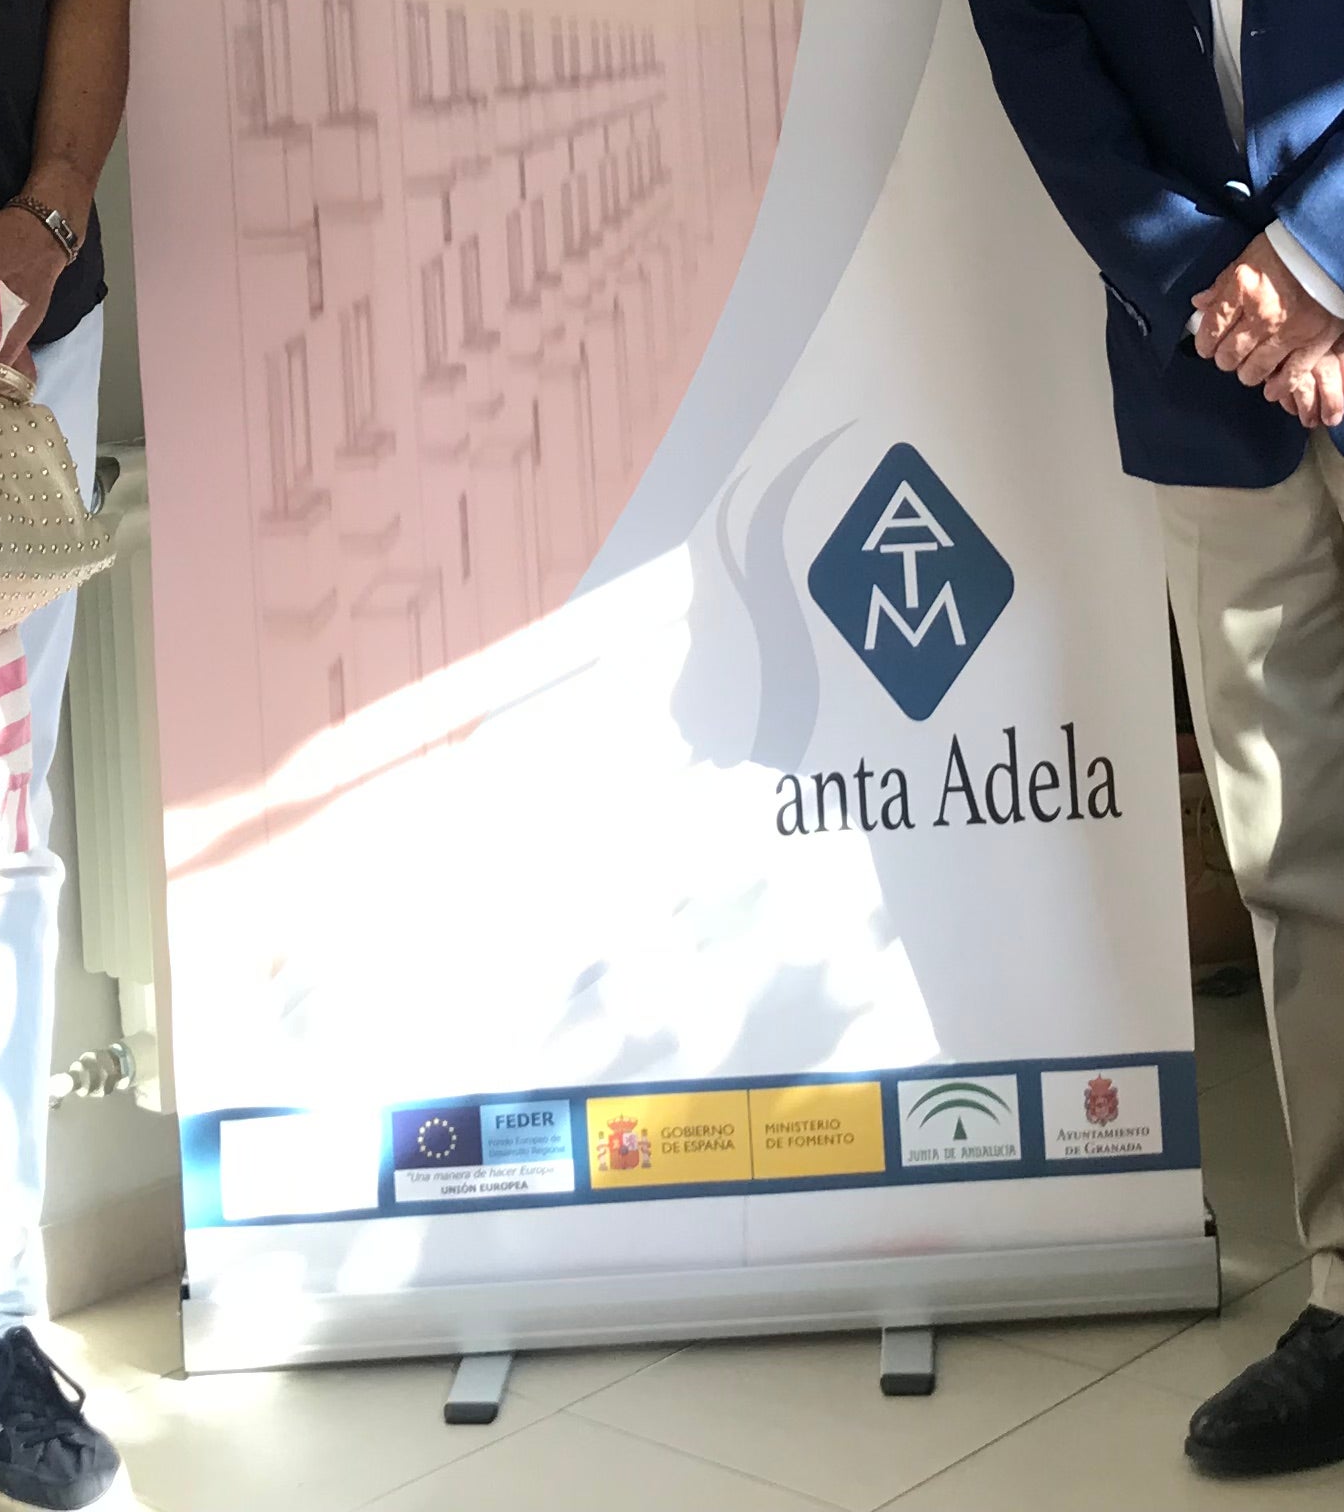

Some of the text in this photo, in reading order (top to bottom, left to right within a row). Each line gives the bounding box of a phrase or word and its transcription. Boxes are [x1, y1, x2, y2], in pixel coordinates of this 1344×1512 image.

[933, 722, 1123, 826] Adela
[495, 1112, 555, 1129] FEDER
[765, 1118, 841, 1135] MINISTERIO
[661, 1123, 735, 1139] GOBIERNO
[662, 1142, 680, 1154] DE
[766, 1133, 855, 1149] DE FOMENTO
[908, 1148, 940, 1162] JUNTA
[944, 1147, 956, 1159] DE
[433, 1170, 471, 1181] manera
[473, 1167, 487, 1179] de
[489, 1166, 517, 1178] hacer
[479, 1181, 529, 1193] EUROPEA
